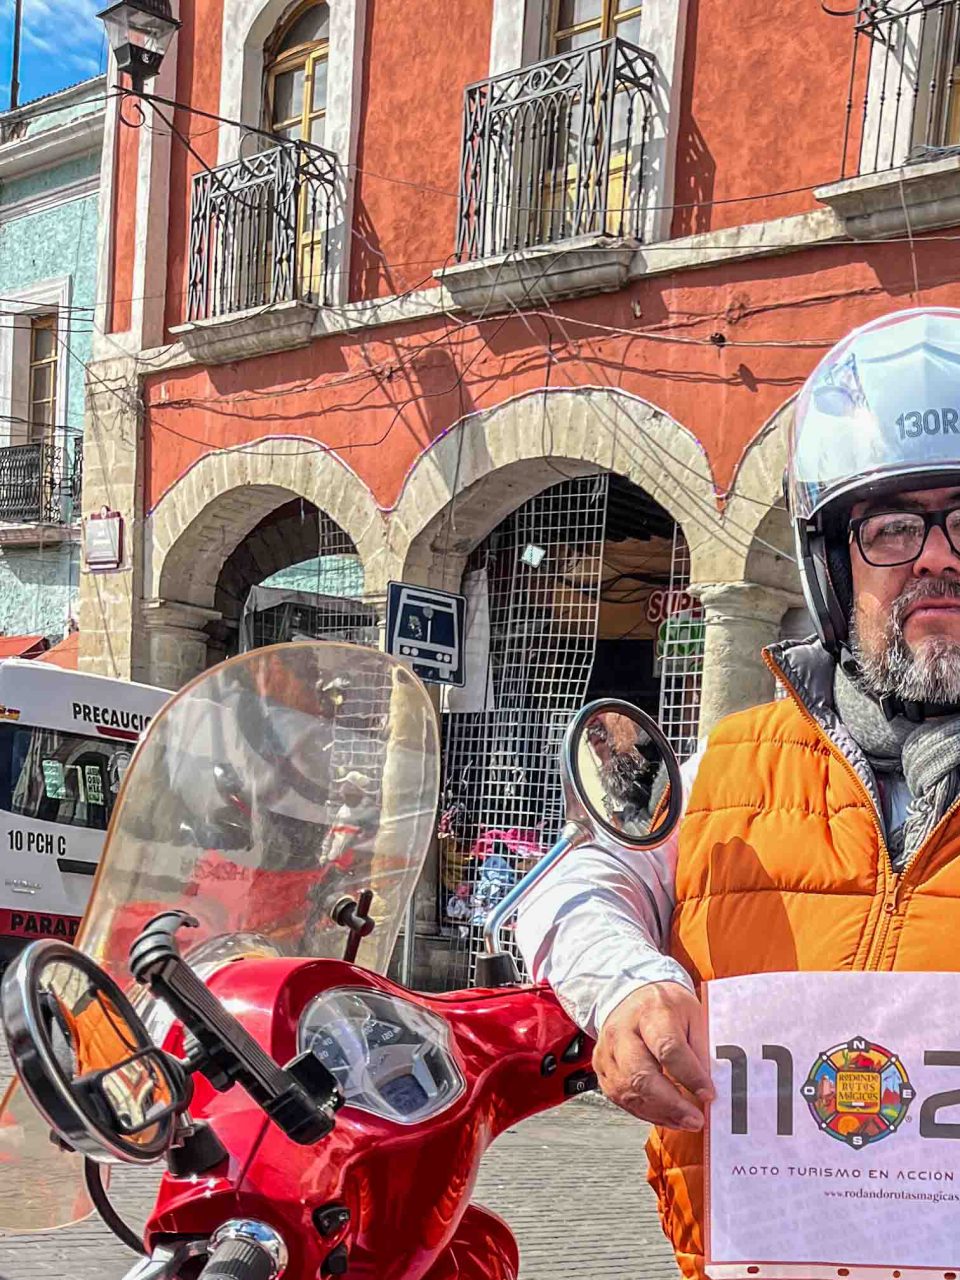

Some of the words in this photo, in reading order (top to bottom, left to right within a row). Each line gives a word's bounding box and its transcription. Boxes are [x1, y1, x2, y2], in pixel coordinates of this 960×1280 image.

[895, 408, 960, 440] 130R
[8, 830, 23, 851] 10
[27, 832, 54, 854] PCH
[57, 836, 66, 856] C
[853, 1041, 865, 1049] N
[902, 1089, 913, 1098] E
[852, 1136, 863, 1145] S
[732, 1165, 780, 1176] MOTO
[788, 1166, 861, 1178] TURISMO
[868, 1168, 889, 1179] EN
